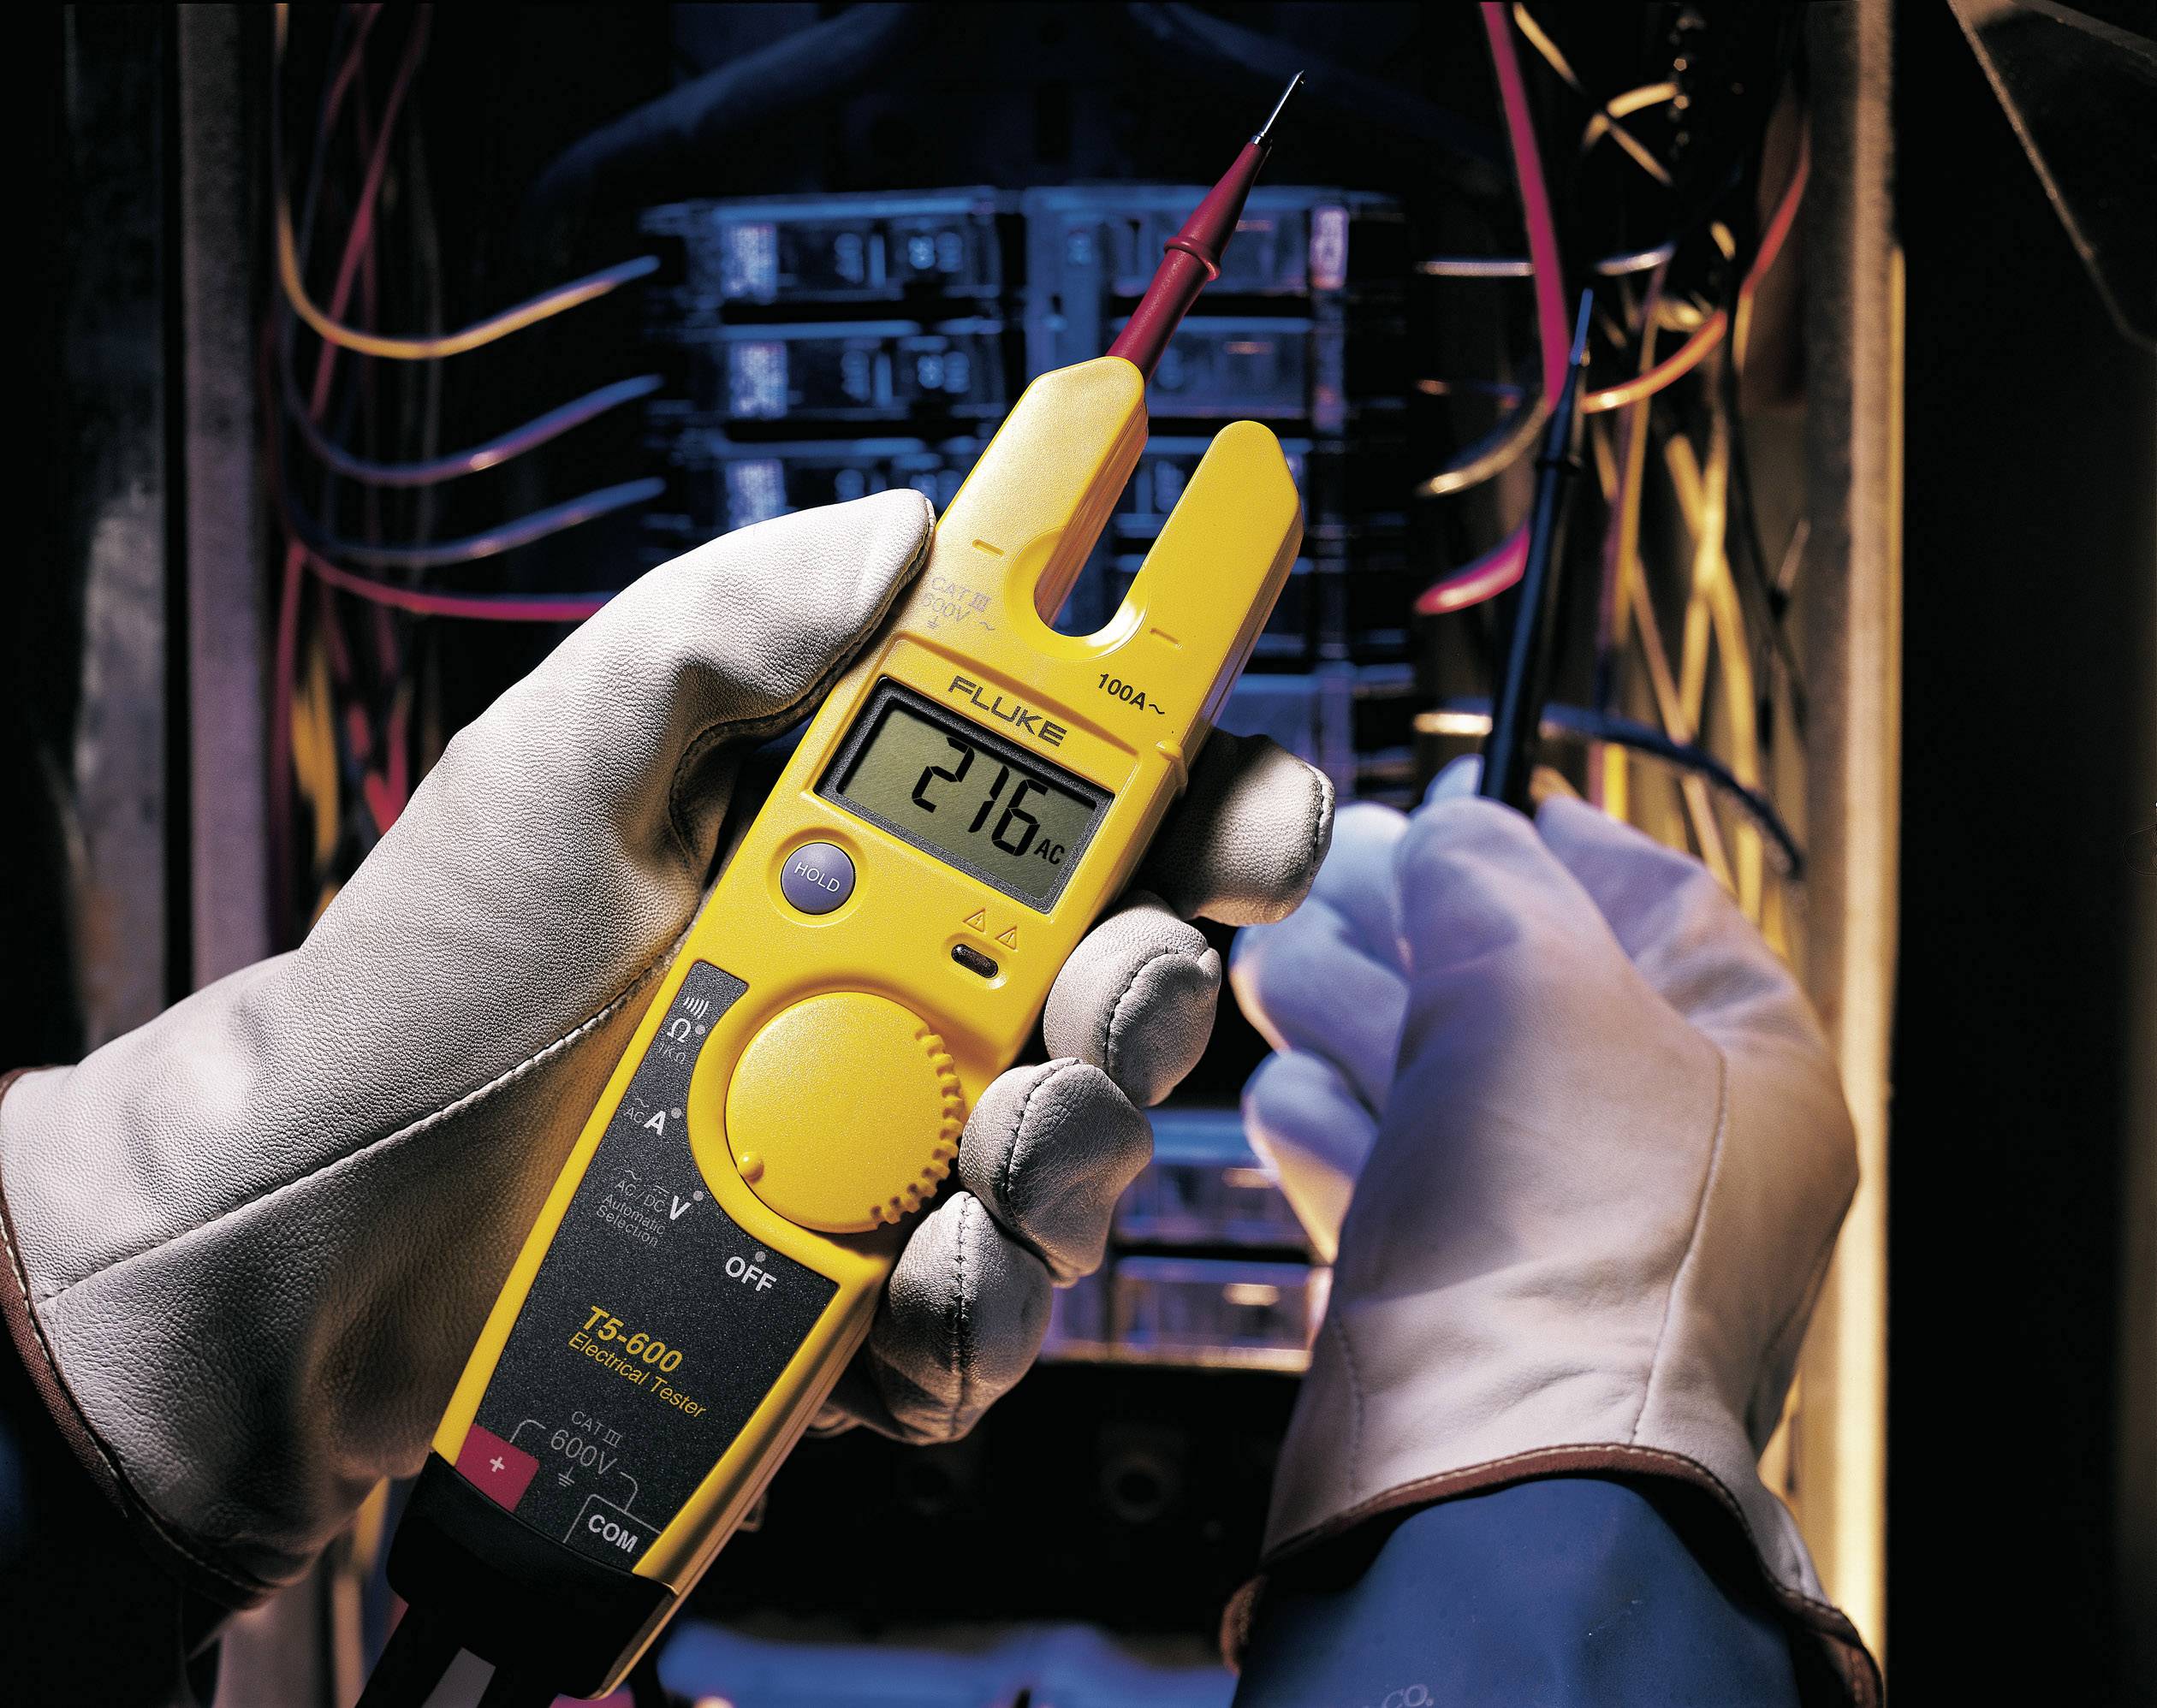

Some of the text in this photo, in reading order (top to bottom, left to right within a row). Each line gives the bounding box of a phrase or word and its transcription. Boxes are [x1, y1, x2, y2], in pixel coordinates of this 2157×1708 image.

[948, 675, 1067, 746] FLUKE
[912, 737, 1065, 865] 216 AC
[793, 862, 840, 893] HOLD
[623, 1107, 666, 1136] AC A
[597, 1205, 658, 1247] Selection
[603, 1195, 665, 1234] Automatic
[669, 1195, 692, 1220] V
[725, 1256, 776, 1292] OFF
[582, 1305, 683, 1373] T5-600
[567, 1331, 706, 1418] Electrical Tester
[571, 1411, 604, 1435] CAT
[550, 1429, 618, 1474] 600V
[588, 1515, 639, 1552] COM
